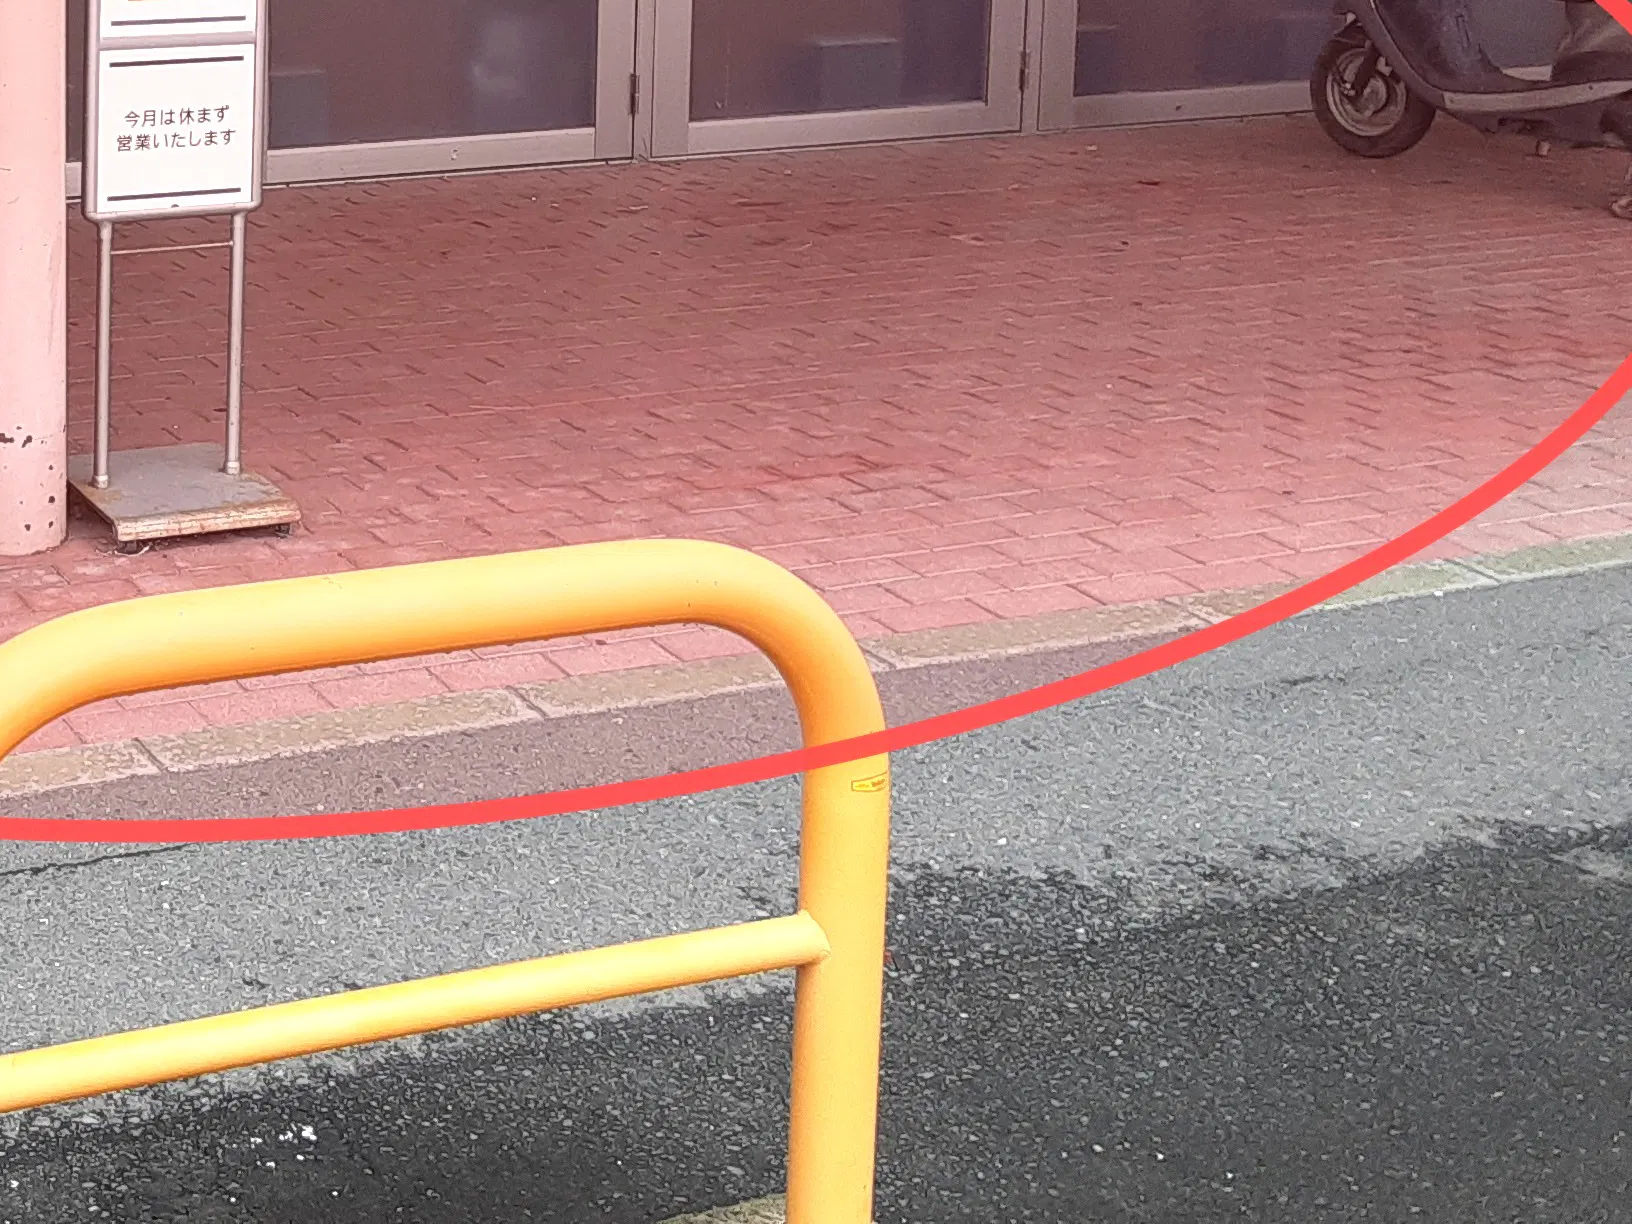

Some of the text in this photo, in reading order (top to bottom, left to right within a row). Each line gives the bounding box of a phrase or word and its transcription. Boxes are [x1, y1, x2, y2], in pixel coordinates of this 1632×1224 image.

[124, 105, 230, 128] 今月は休まず
[116, 129, 236, 152] 営業いたします
